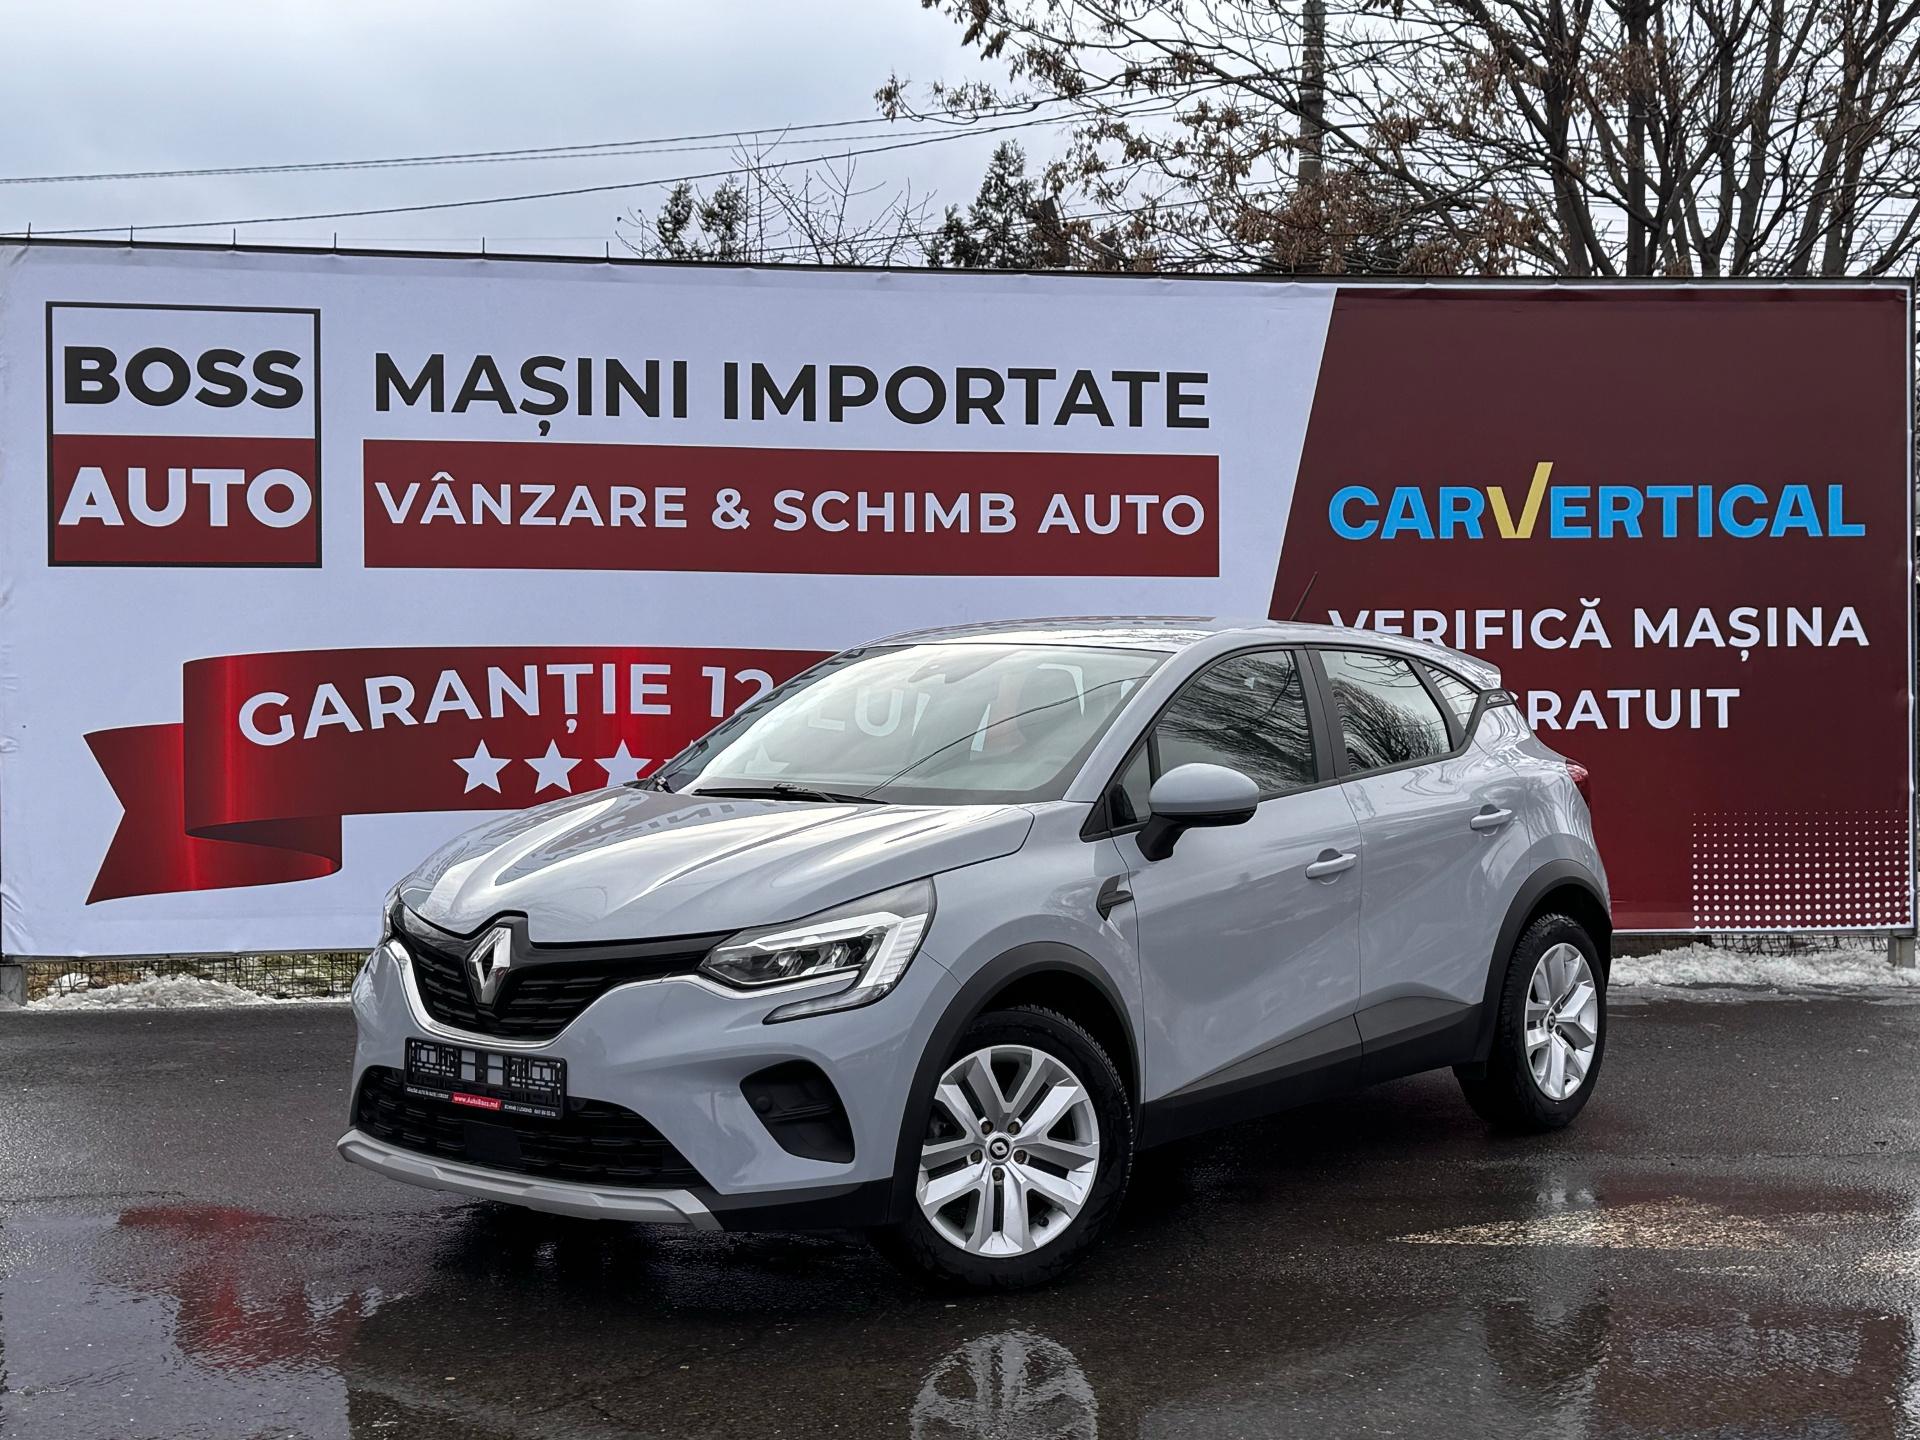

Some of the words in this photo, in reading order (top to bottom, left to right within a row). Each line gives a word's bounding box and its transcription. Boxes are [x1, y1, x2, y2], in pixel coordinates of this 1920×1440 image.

[64, 346, 303, 409] BOSS
[375, 353, 688, 437] MAȘINI
[723, 362, 1210, 428] IMPORTATE
[58, 467, 312, 528] AUTO
[374, 472, 688, 529] VÂNZARE
[711, 488, 750, 530] &
[773, 490, 1017, 534] SCHIMB
[1037, 493, 1205, 535] AUTO
[1328, 461, 1866, 540] CARVERTICAL
[1634, 606, 1870, 662] MAȘINA
[239, 663, 672, 746] GARANȚIE
[702, 666, 774, 718] 12
[1508, 688, 1741, 731] RATUIT
